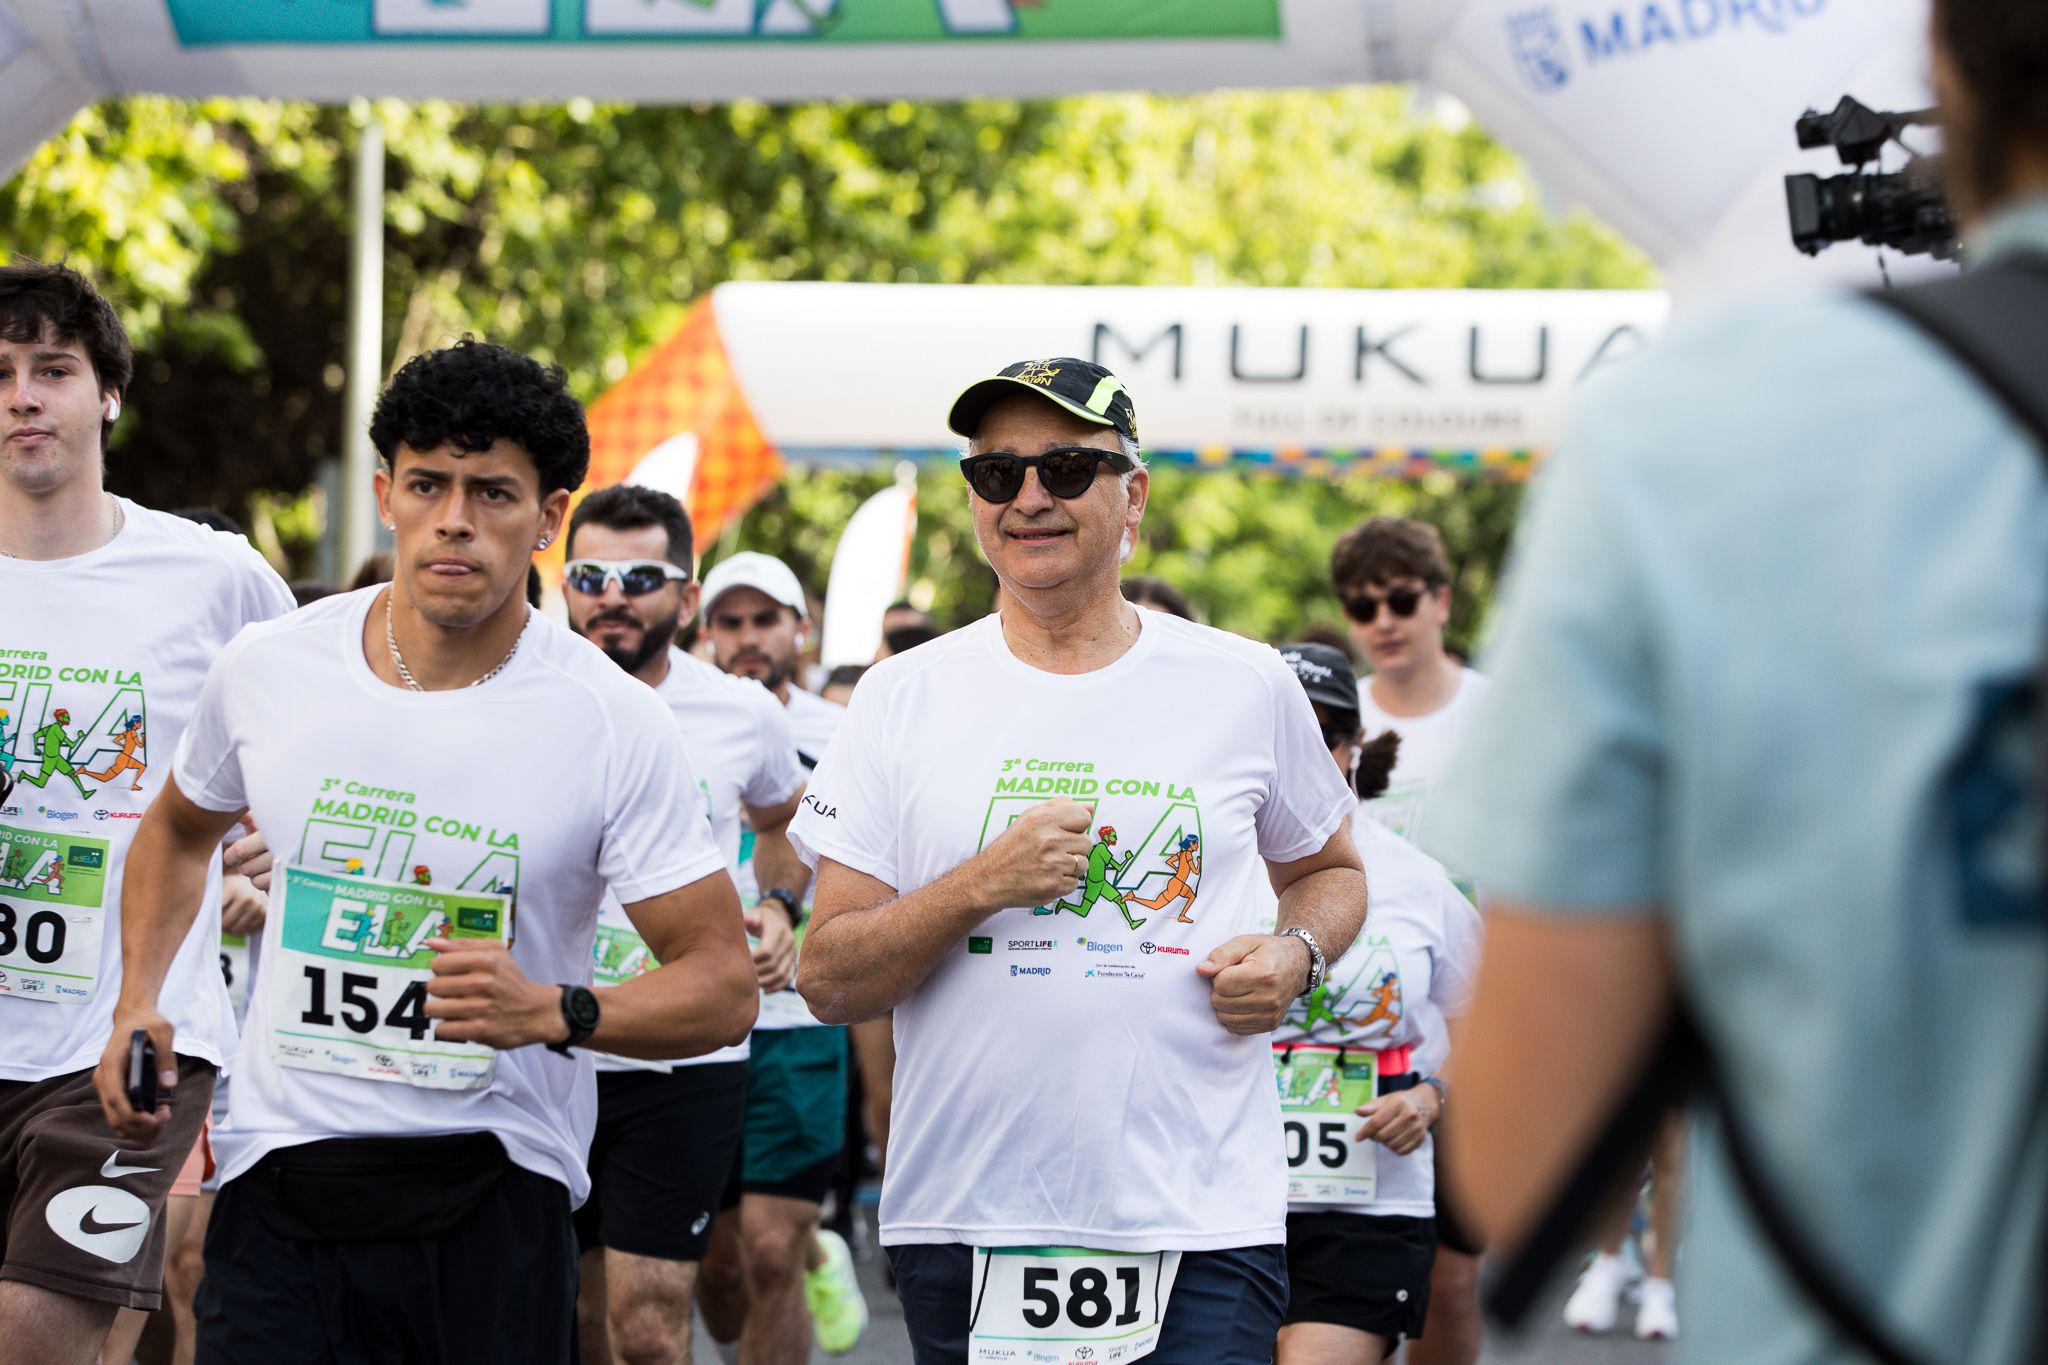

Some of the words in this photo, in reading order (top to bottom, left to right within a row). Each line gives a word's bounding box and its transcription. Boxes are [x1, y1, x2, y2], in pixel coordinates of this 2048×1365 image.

[58, 667, 109, 684] CON
[114, 671, 142, 686] LA
[1025, 758, 1094, 773] Carrera
[345, 781, 416, 804] Carrera
[995, 777, 1098, 795] MADRID
[1105, 779, 1160, 798] CON
[1167, 783, 1197, 802] LA
[46, 809, 78, 824] Biogen
[311, 798, 417, 828] MADRID
[424, 816, 482, 843] CON
[487, 829, 520, 850] LA
[14, 834, 41, 846] CON
[42, 839, 59, 848] LA
[334, 883, 391, 901] MADRID
[393, 894, 426, 906] CON
[426, 898, 446, 909] LA
[1008, 940, 1053, 948] SPORTLIFE
[1086, 941, 1123, 954] Biogen
[1019, 967, 1051, 976] MADRID
[62, 987, 87, 996] MADRID
[301, 965, 468, 1044] 154
[1022, 1267, 1141, 1328] 581
[979, 1348, 1016, 1356] MUKUA
